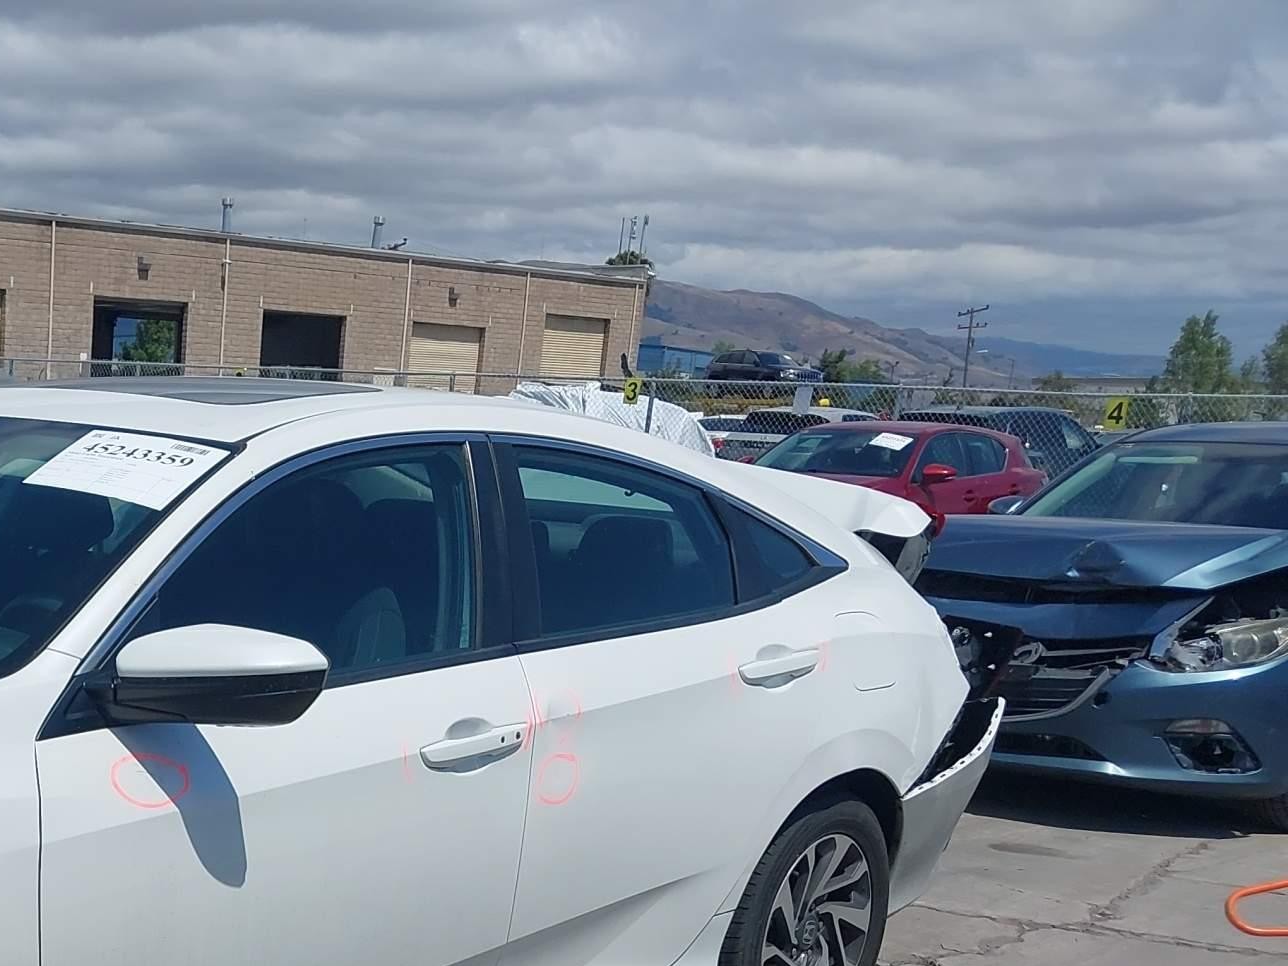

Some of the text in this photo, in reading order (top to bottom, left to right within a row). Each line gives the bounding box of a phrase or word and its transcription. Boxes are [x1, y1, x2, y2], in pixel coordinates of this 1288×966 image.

[625, 381, 638, 401] 3
[1107, 401, 1124, 425] 4
[82, 442, 195, 468] 45243359
